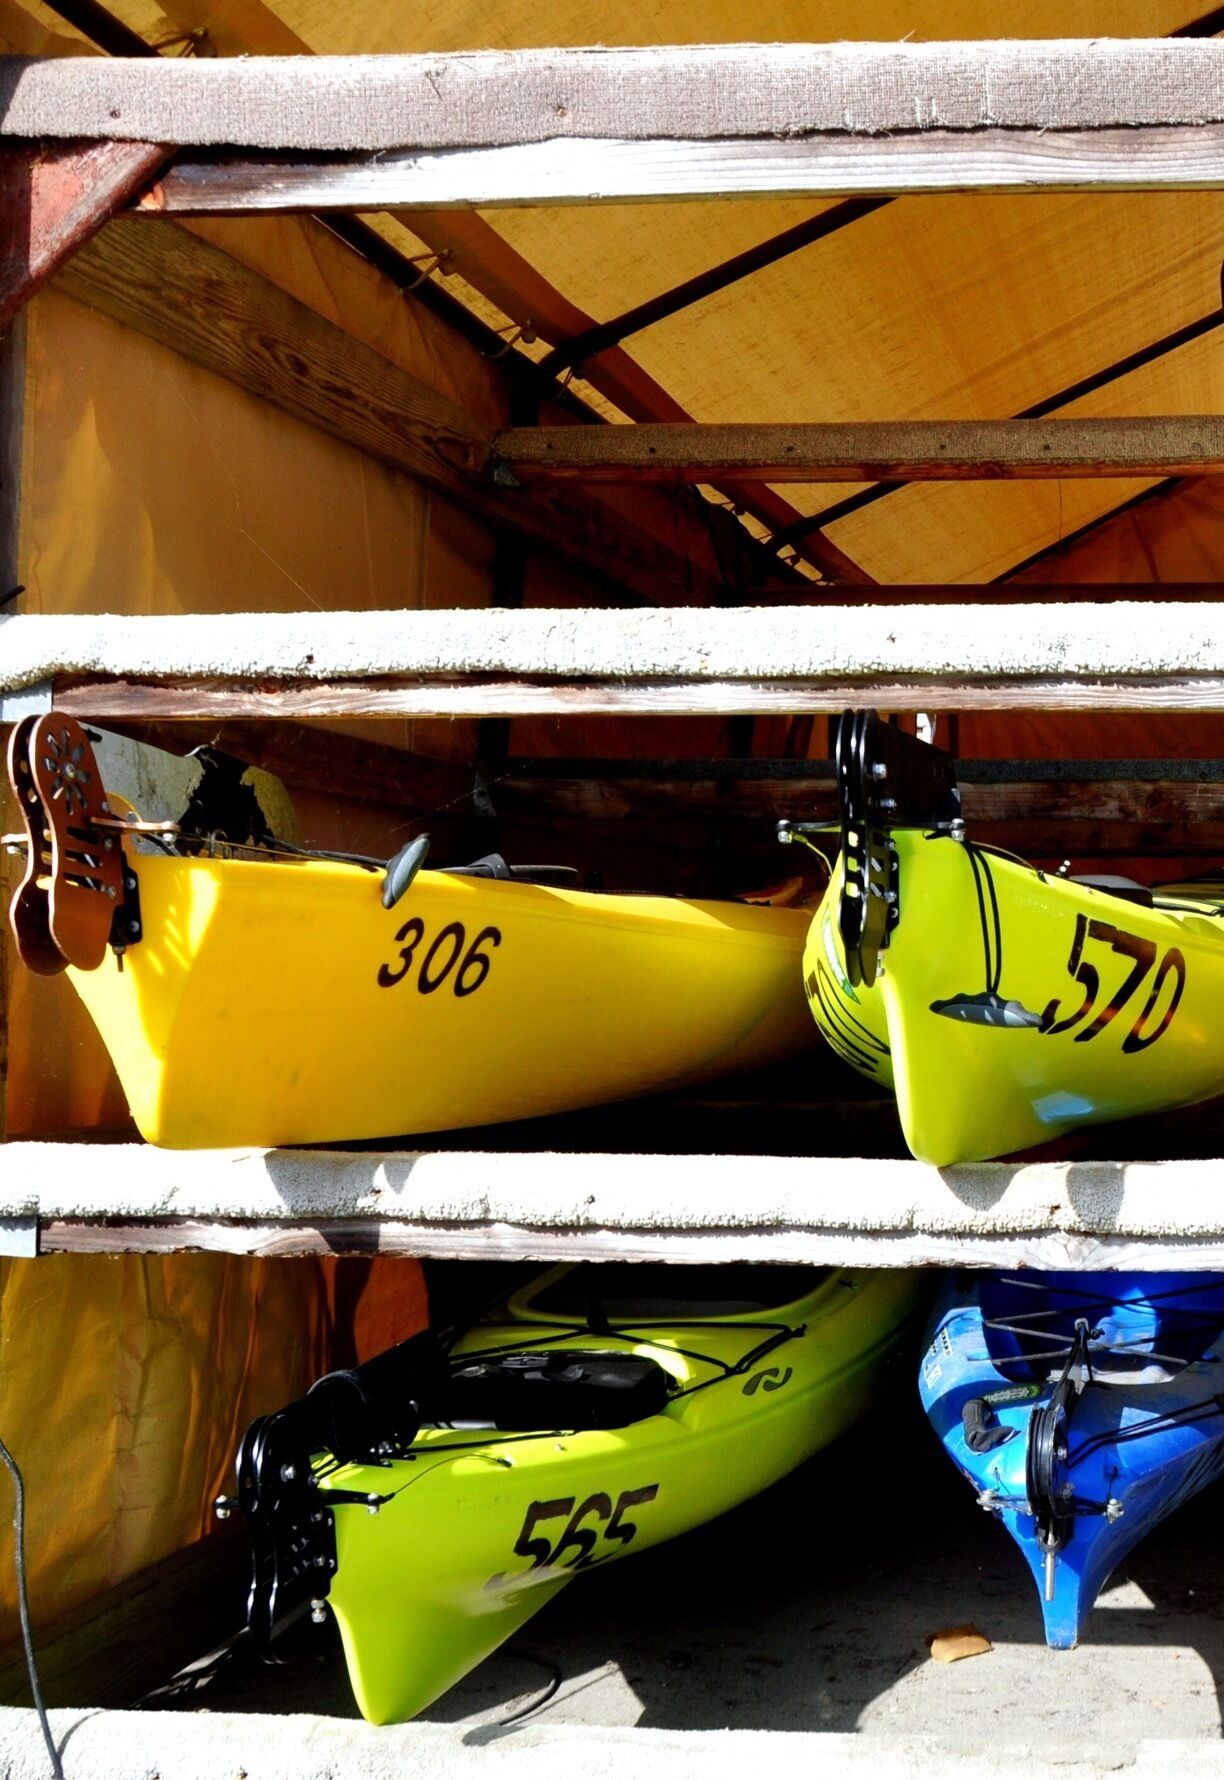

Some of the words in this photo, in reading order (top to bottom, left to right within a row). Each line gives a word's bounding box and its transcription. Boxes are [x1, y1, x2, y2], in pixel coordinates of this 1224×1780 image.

[377, 917, 502, 997] 306
[1038, 912, 1186, 1054] 570
[483, 1483, 660, 1592] 565
